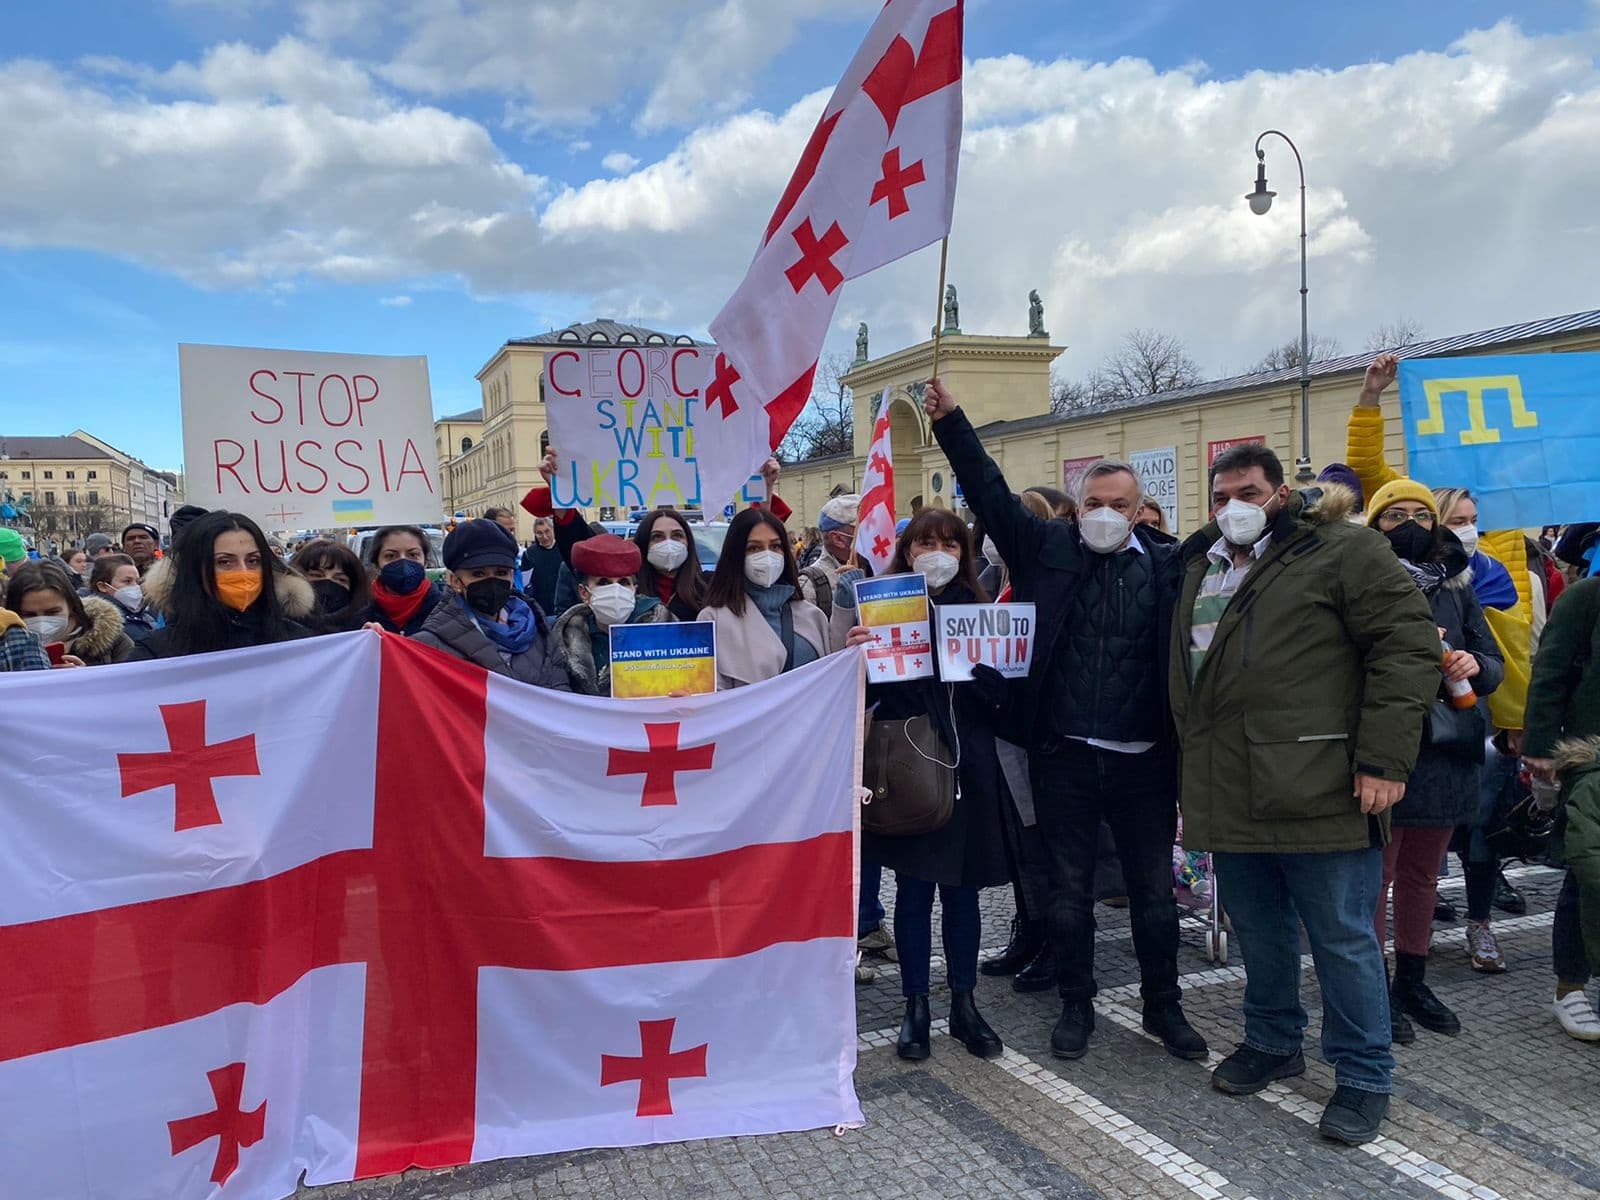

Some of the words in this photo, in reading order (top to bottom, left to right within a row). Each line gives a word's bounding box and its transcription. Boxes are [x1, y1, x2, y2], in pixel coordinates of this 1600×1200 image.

[549, 348, 713, 398] GEORG
[250, 369, 379, 427] STOP
[214, 438, 433, 495] RUSSIA
[551, 457, 764, 507] UKRAIE
[862, 593, 882, 601] STAND
[899, 589, 925, 597] UKRAINE
[946, 617, 976, 637] SAY
[979, 609, 1011, 637] NO
[1012, 617, 1029, 636] TO
[612, 650, 642, 659] STAND
[644, 648, 667, 657] WITH
[669, 646, 710, 656] UKRAINE
[947, 638, 1028, 665] PUTIN
